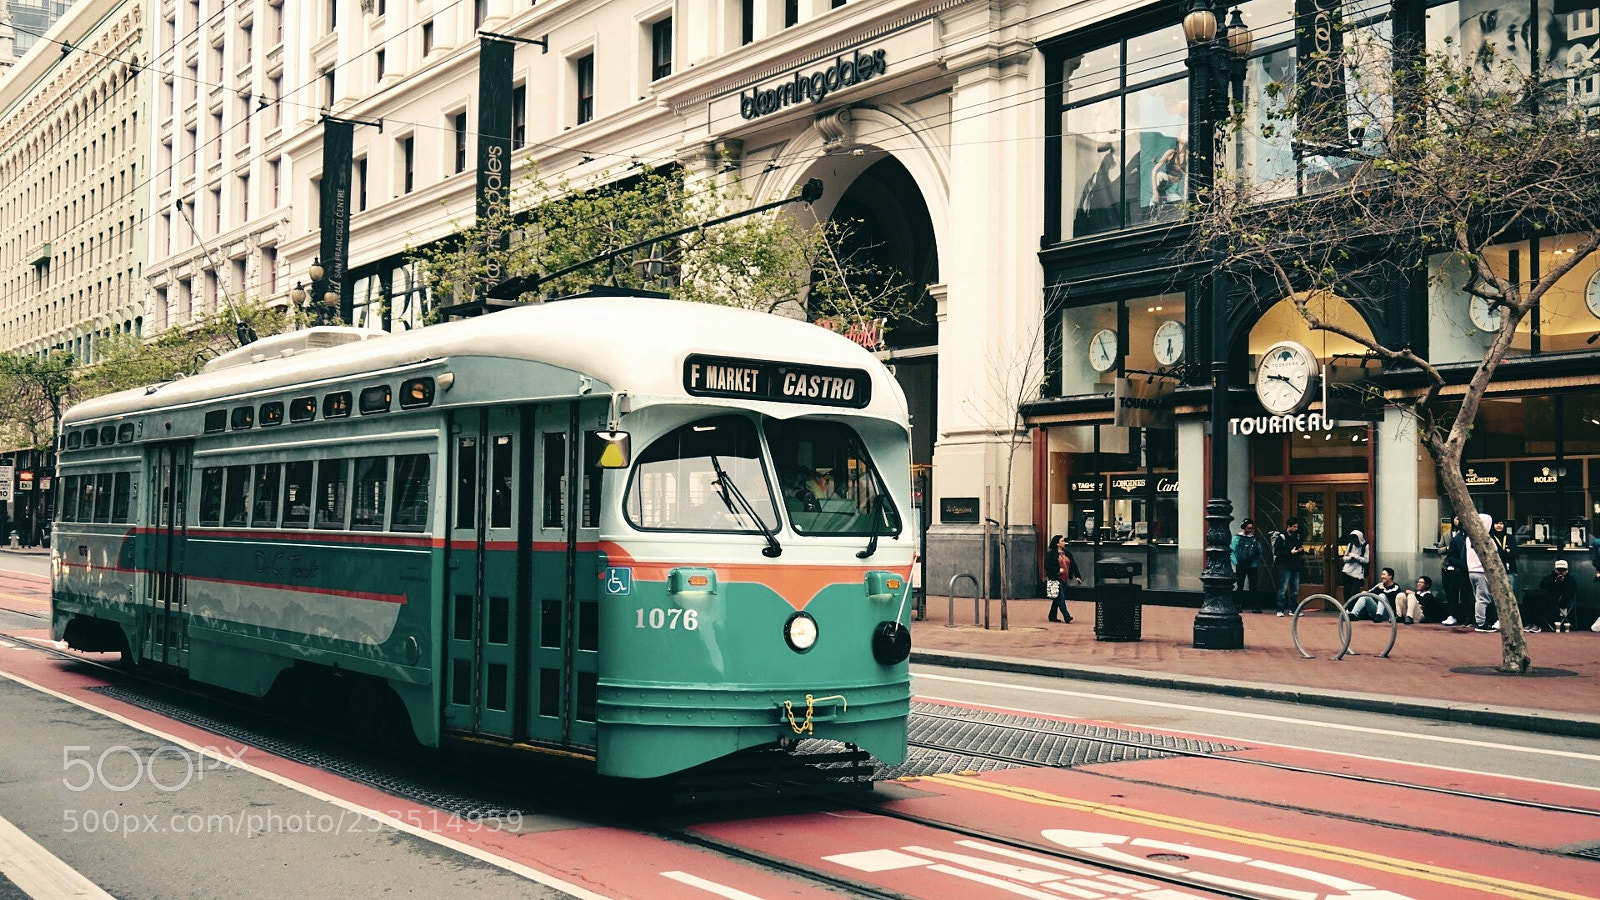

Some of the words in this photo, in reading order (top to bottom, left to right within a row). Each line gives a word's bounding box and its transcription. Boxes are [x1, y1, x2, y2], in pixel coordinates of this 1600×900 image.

[336, 188, 345, 218] CENTRE
[334, 219, 344, 261] FRANCISCO
[691, 364, 700, 388] F
[706, 365, 759, 393] MARKET
[783, 373, 855, 401] CASTRO
[1230, 412, 1334, 435] TOURNEAU
[1112, 479, 1146, 488] LONGINES
[635, 607, 698, 631] 1076
